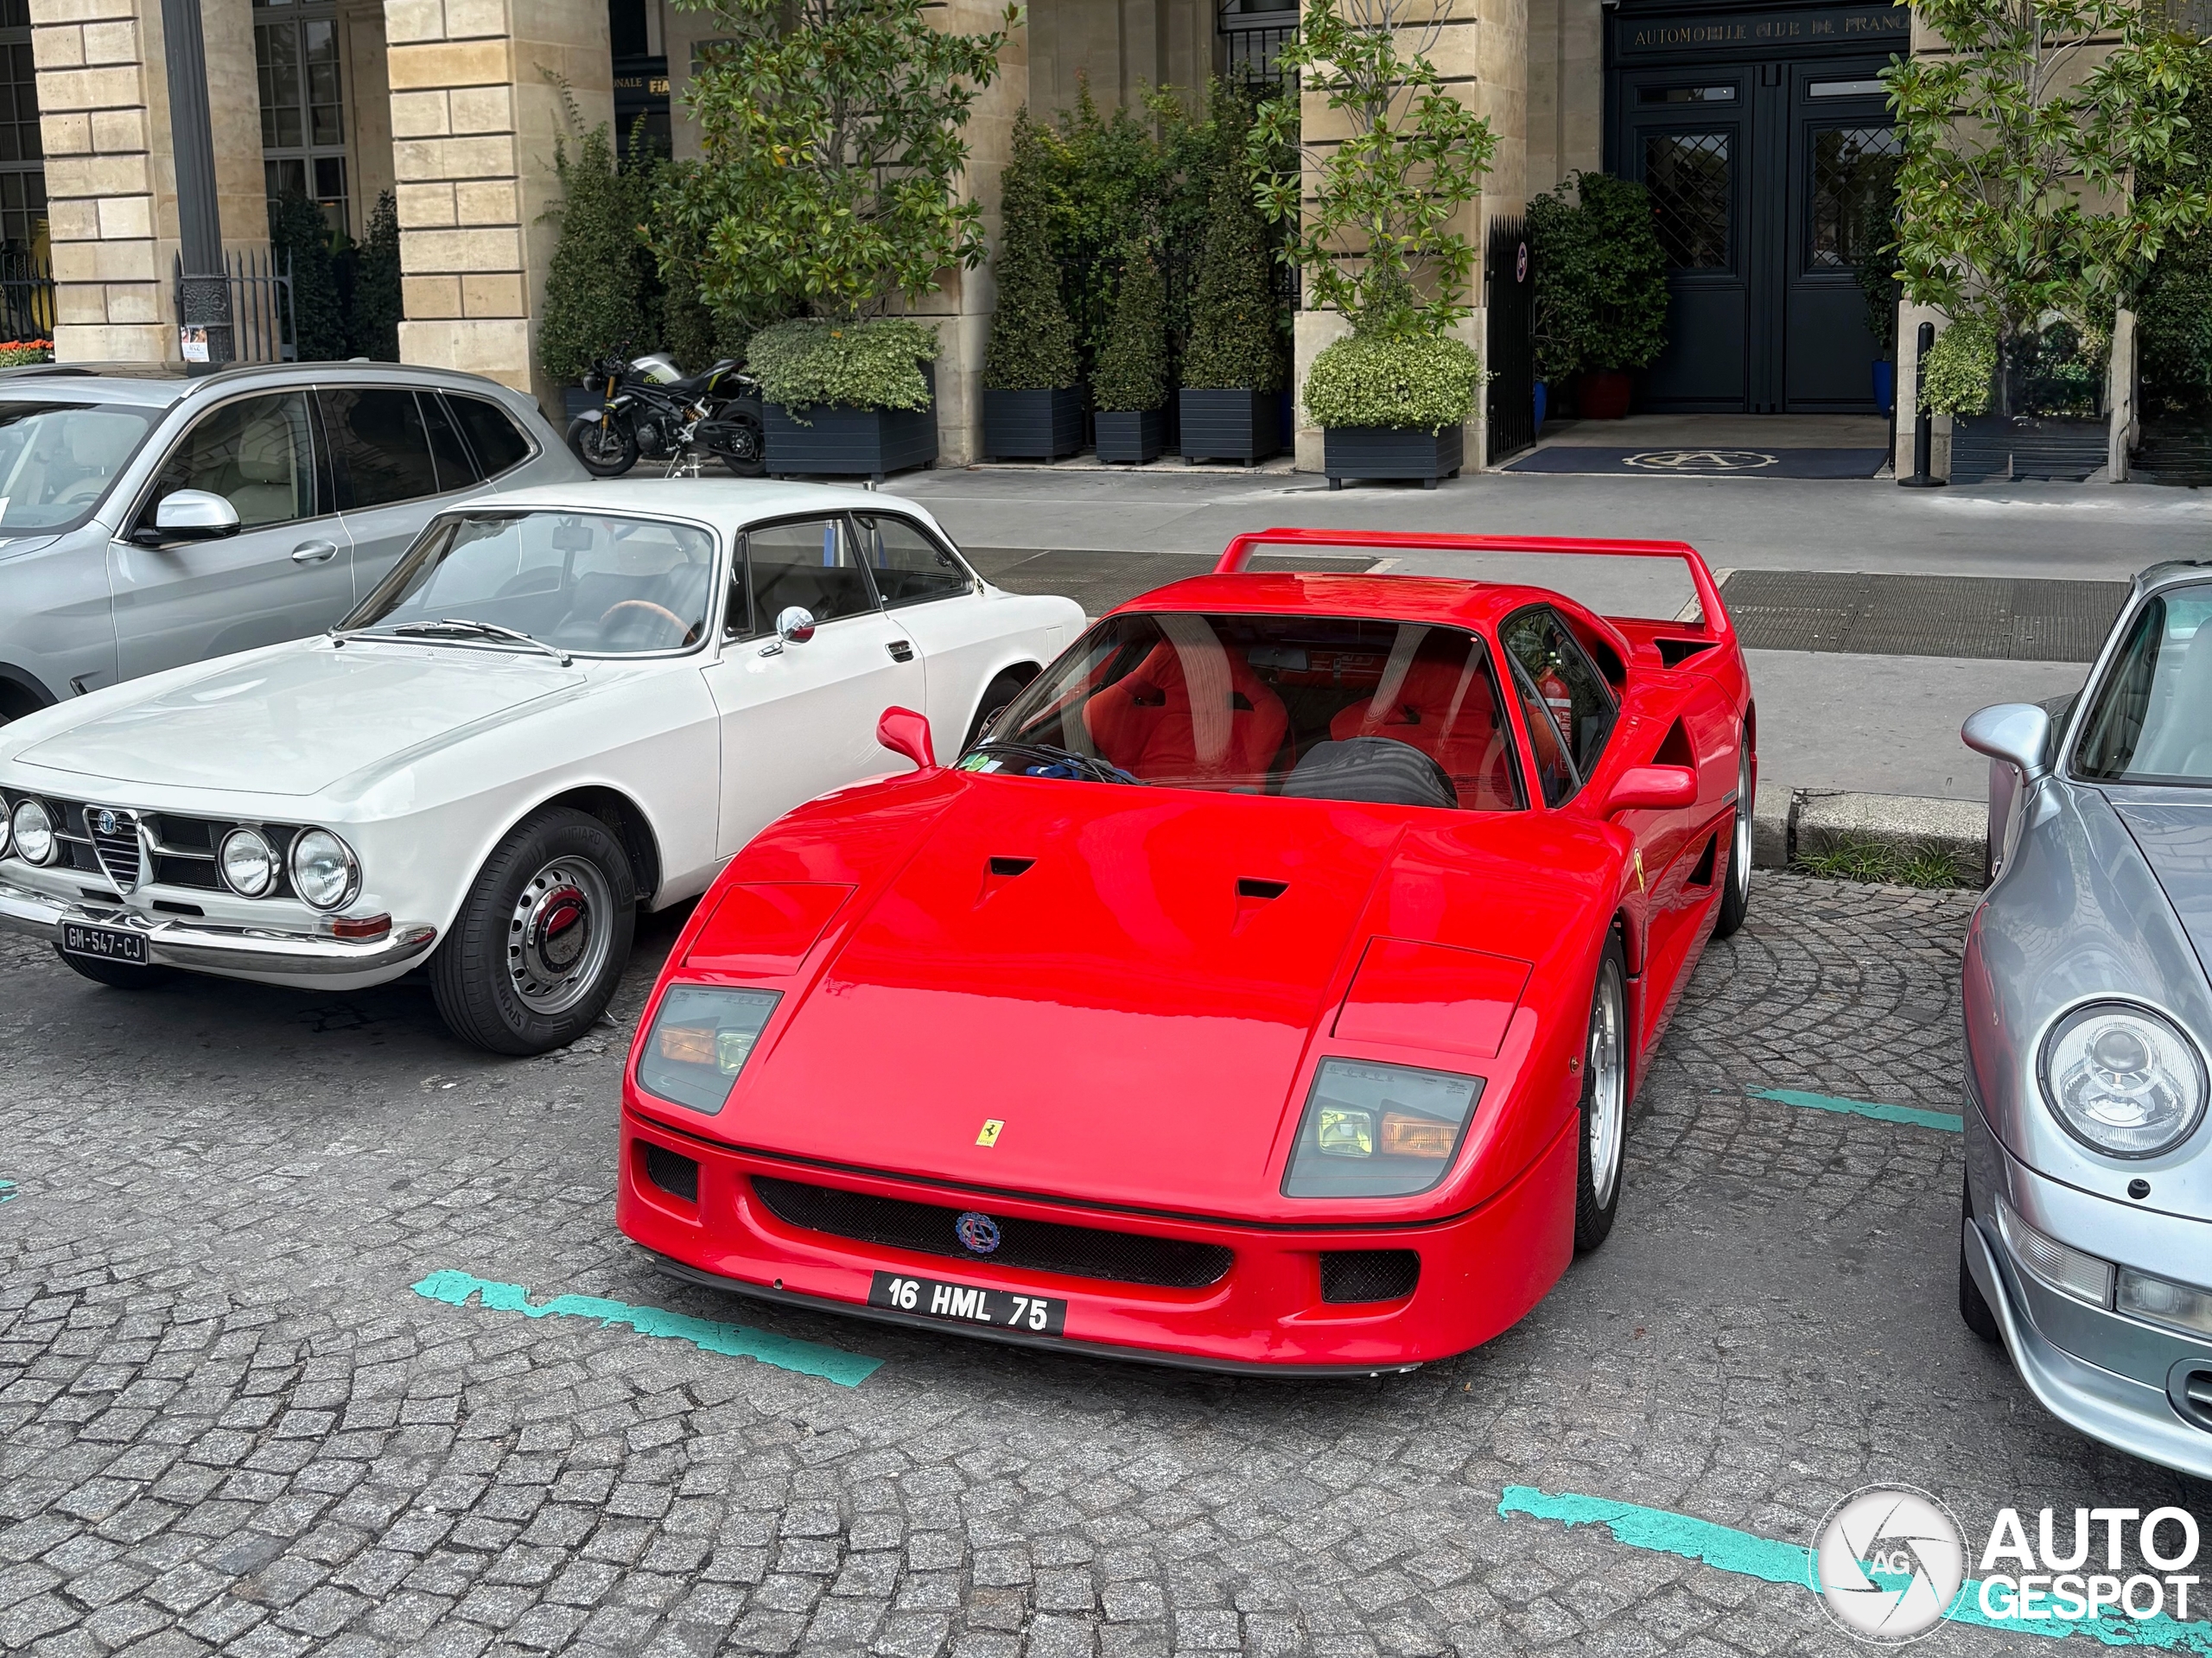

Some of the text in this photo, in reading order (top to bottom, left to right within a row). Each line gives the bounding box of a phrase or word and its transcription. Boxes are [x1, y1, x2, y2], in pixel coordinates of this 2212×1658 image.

[1635, 14, 1910, 45] AUTOMOBILE CLUB DE FRANC
[69, 927, 140, 958] GM-547-CJ
[888, 1278, 1048, 1331] 16 HML 75
